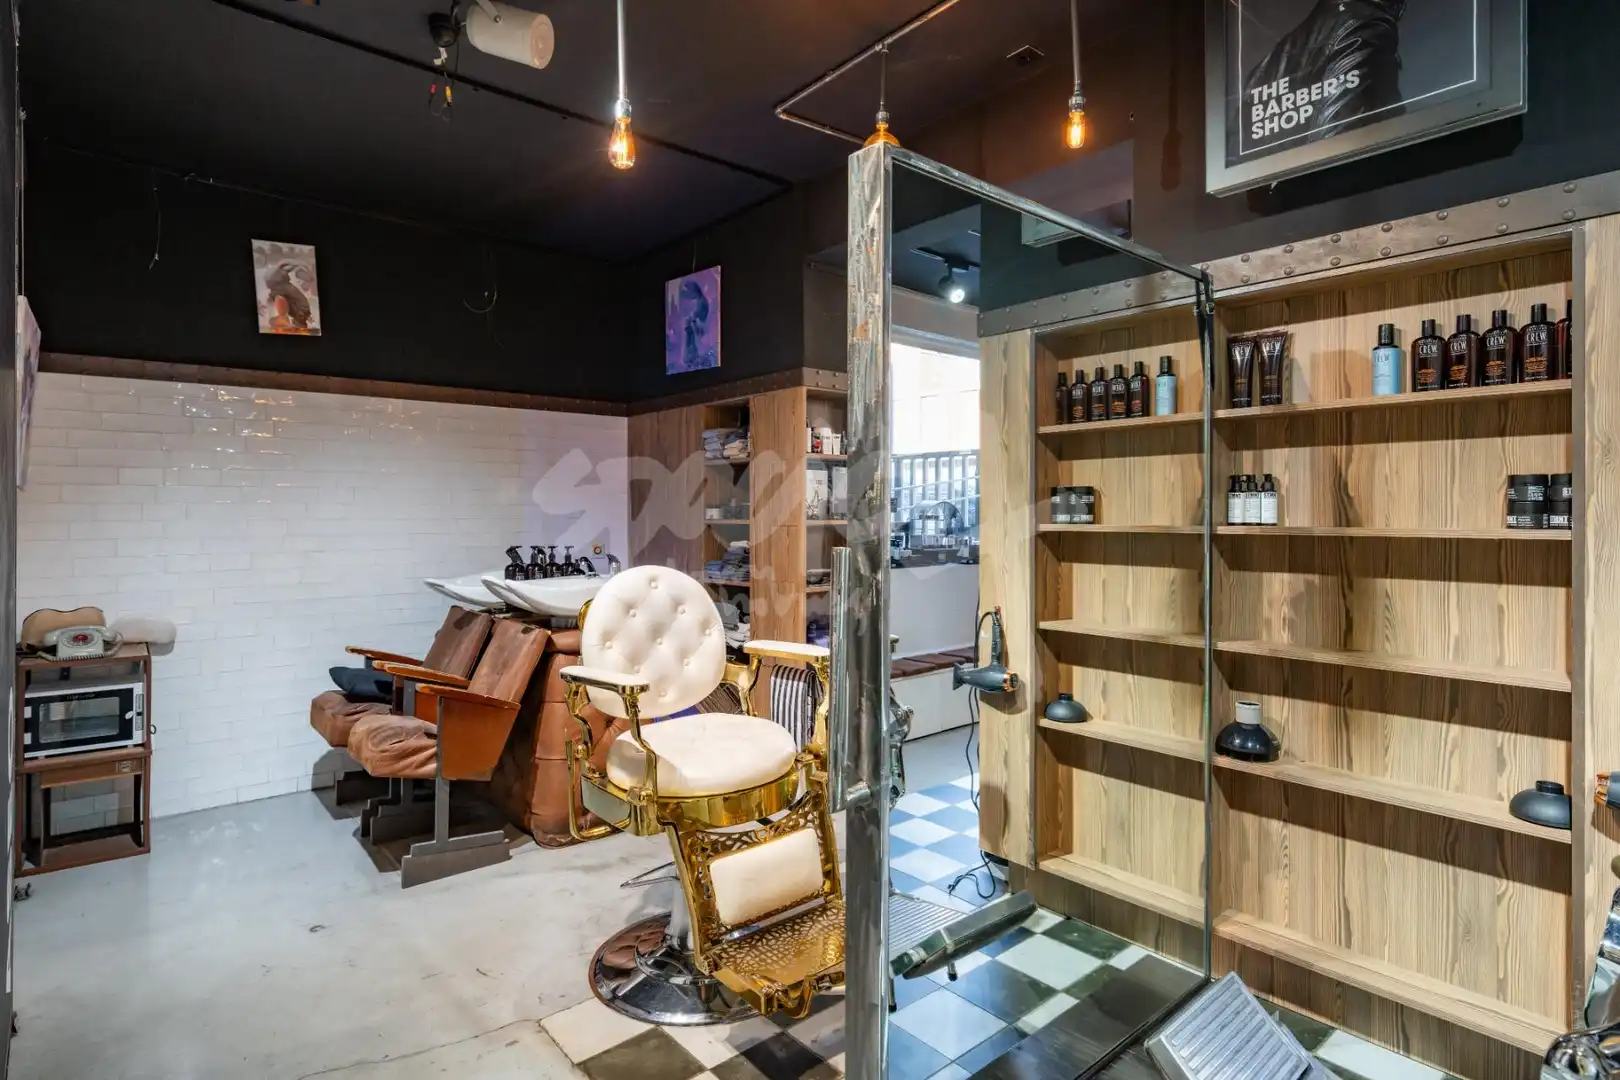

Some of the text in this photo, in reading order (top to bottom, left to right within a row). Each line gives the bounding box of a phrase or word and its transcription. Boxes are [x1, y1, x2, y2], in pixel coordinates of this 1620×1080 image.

[1251, 76, 1290, 104] THE
[1251, 69, 1360, 123] BARBER'S
[1251, 105, 1314, 139] SHOP
[1486, 335, 1506, 346] CREW
[1526, 331, 1548, 342] CREW
[1419, 344, 1438, 354] CREW
[1450, 341, 1467, 352] CREW
